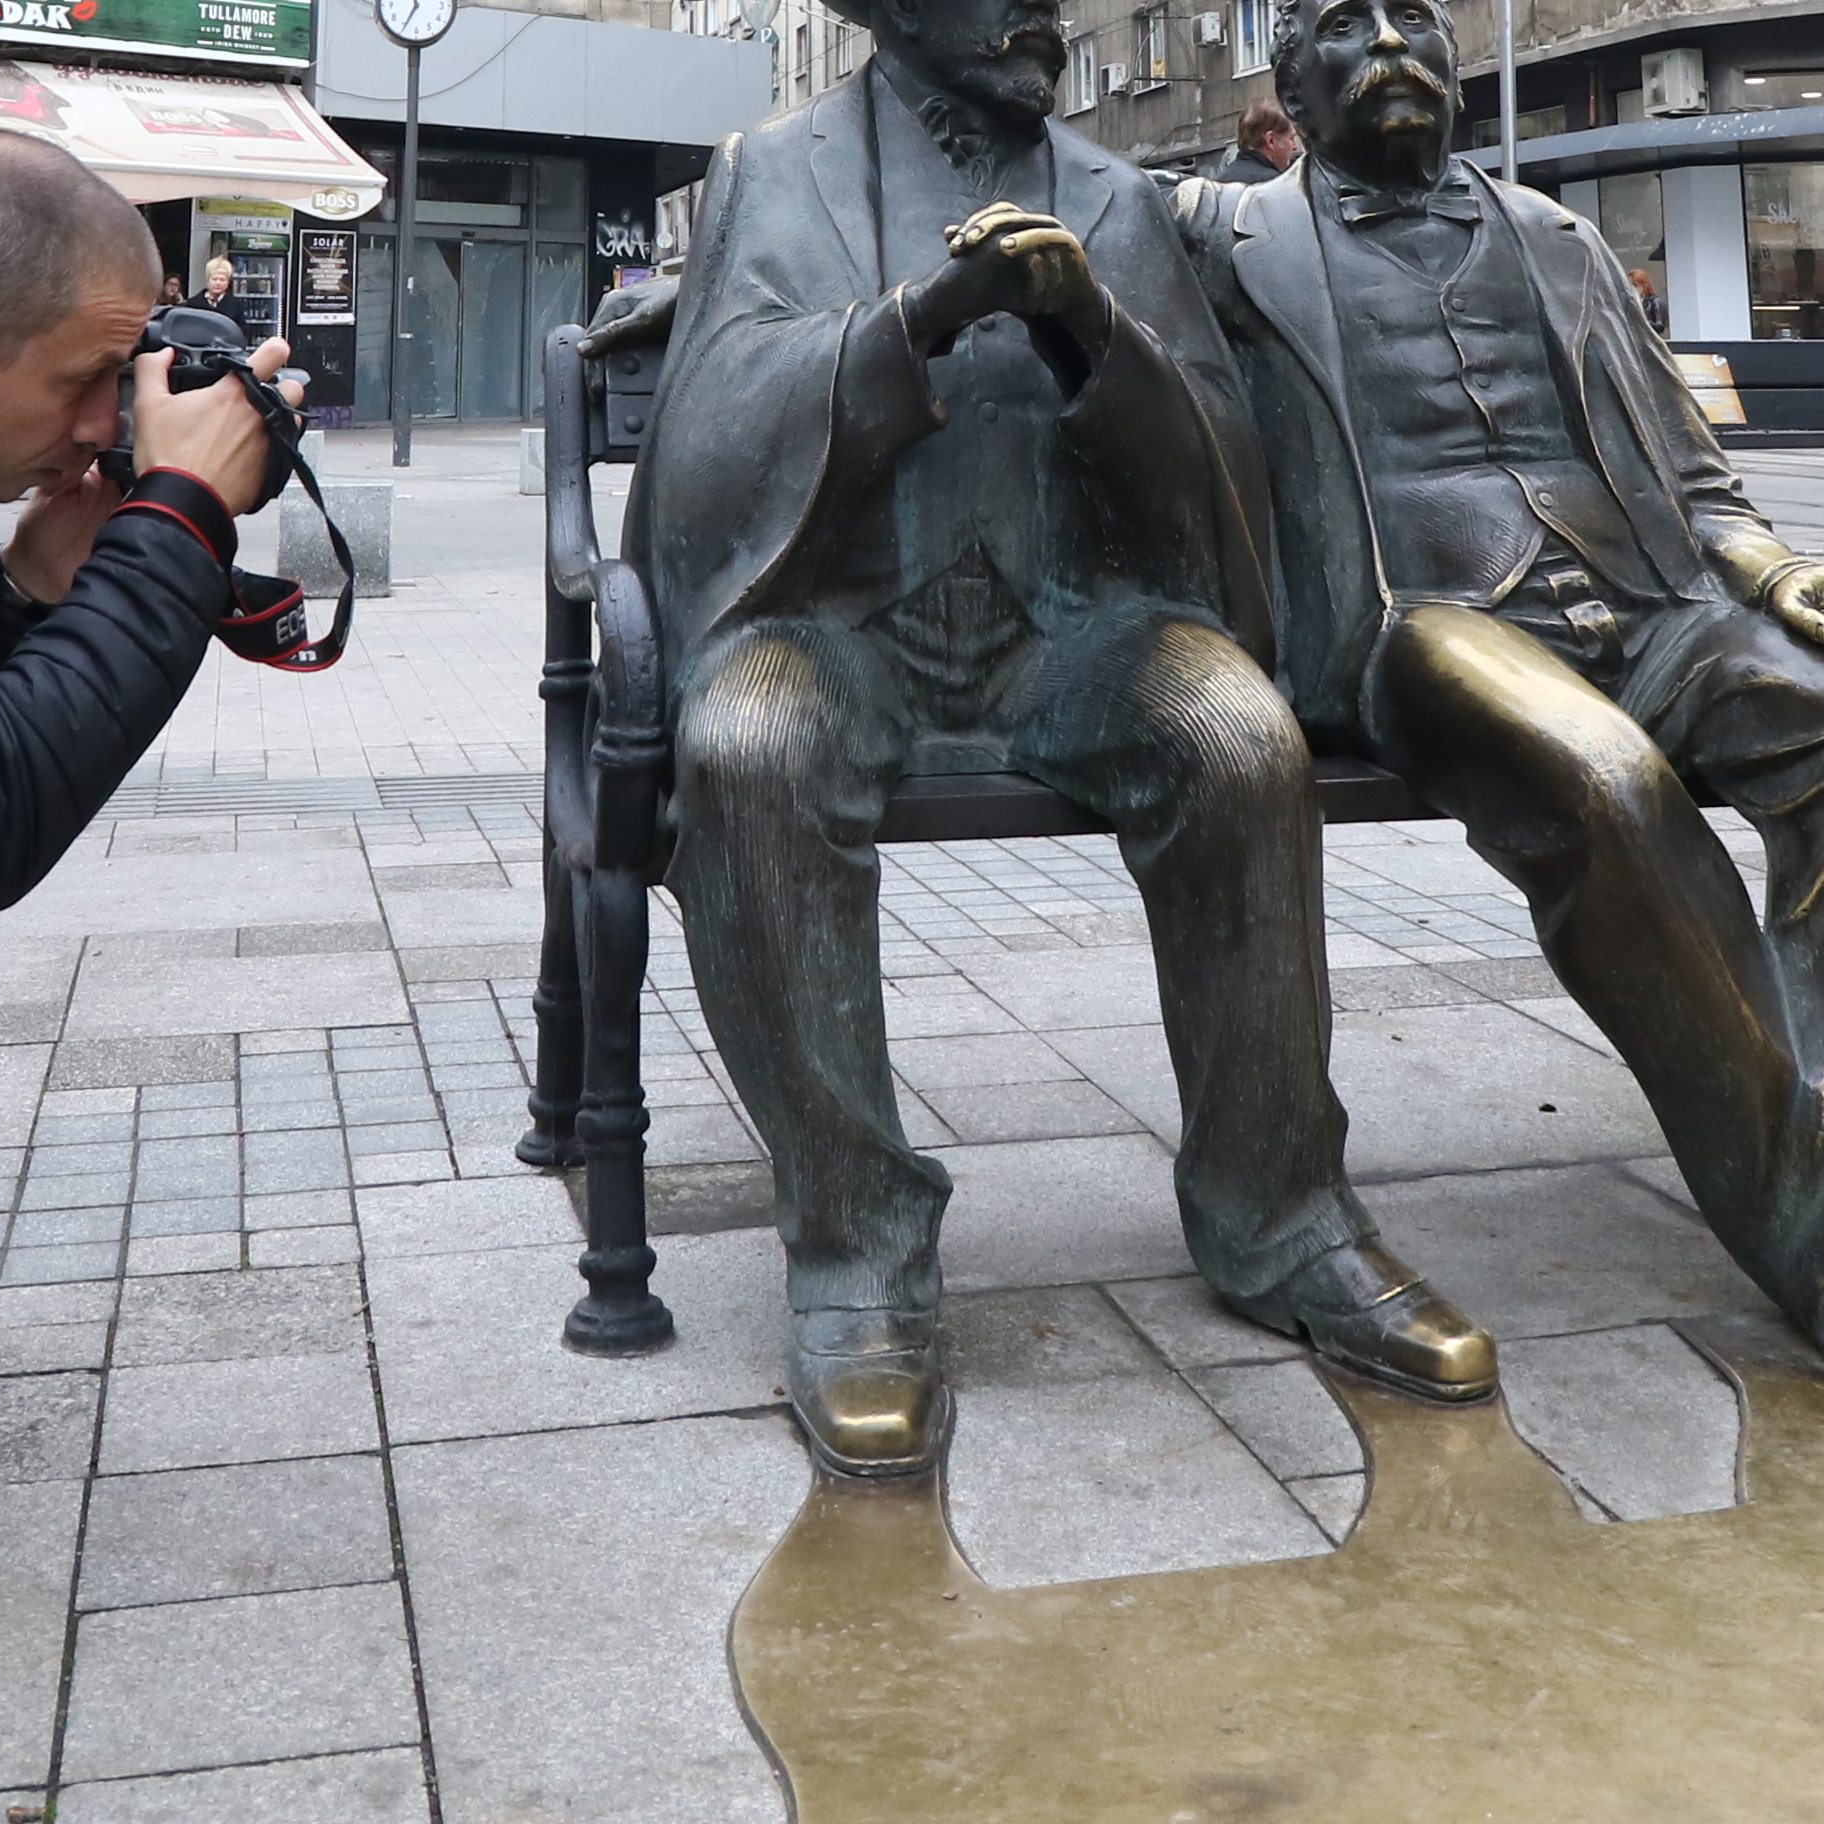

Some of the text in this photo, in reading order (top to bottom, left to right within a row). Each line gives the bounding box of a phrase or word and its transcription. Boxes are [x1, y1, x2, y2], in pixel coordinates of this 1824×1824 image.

[0, 2, 73, 30] DAK
[198, 3, 276, 26] TULLAMORE
[150, 109, 203, 124] BOSS
[314, 193, 356, 208] BOSS
[313, 238, 344, 247] SOLAR
